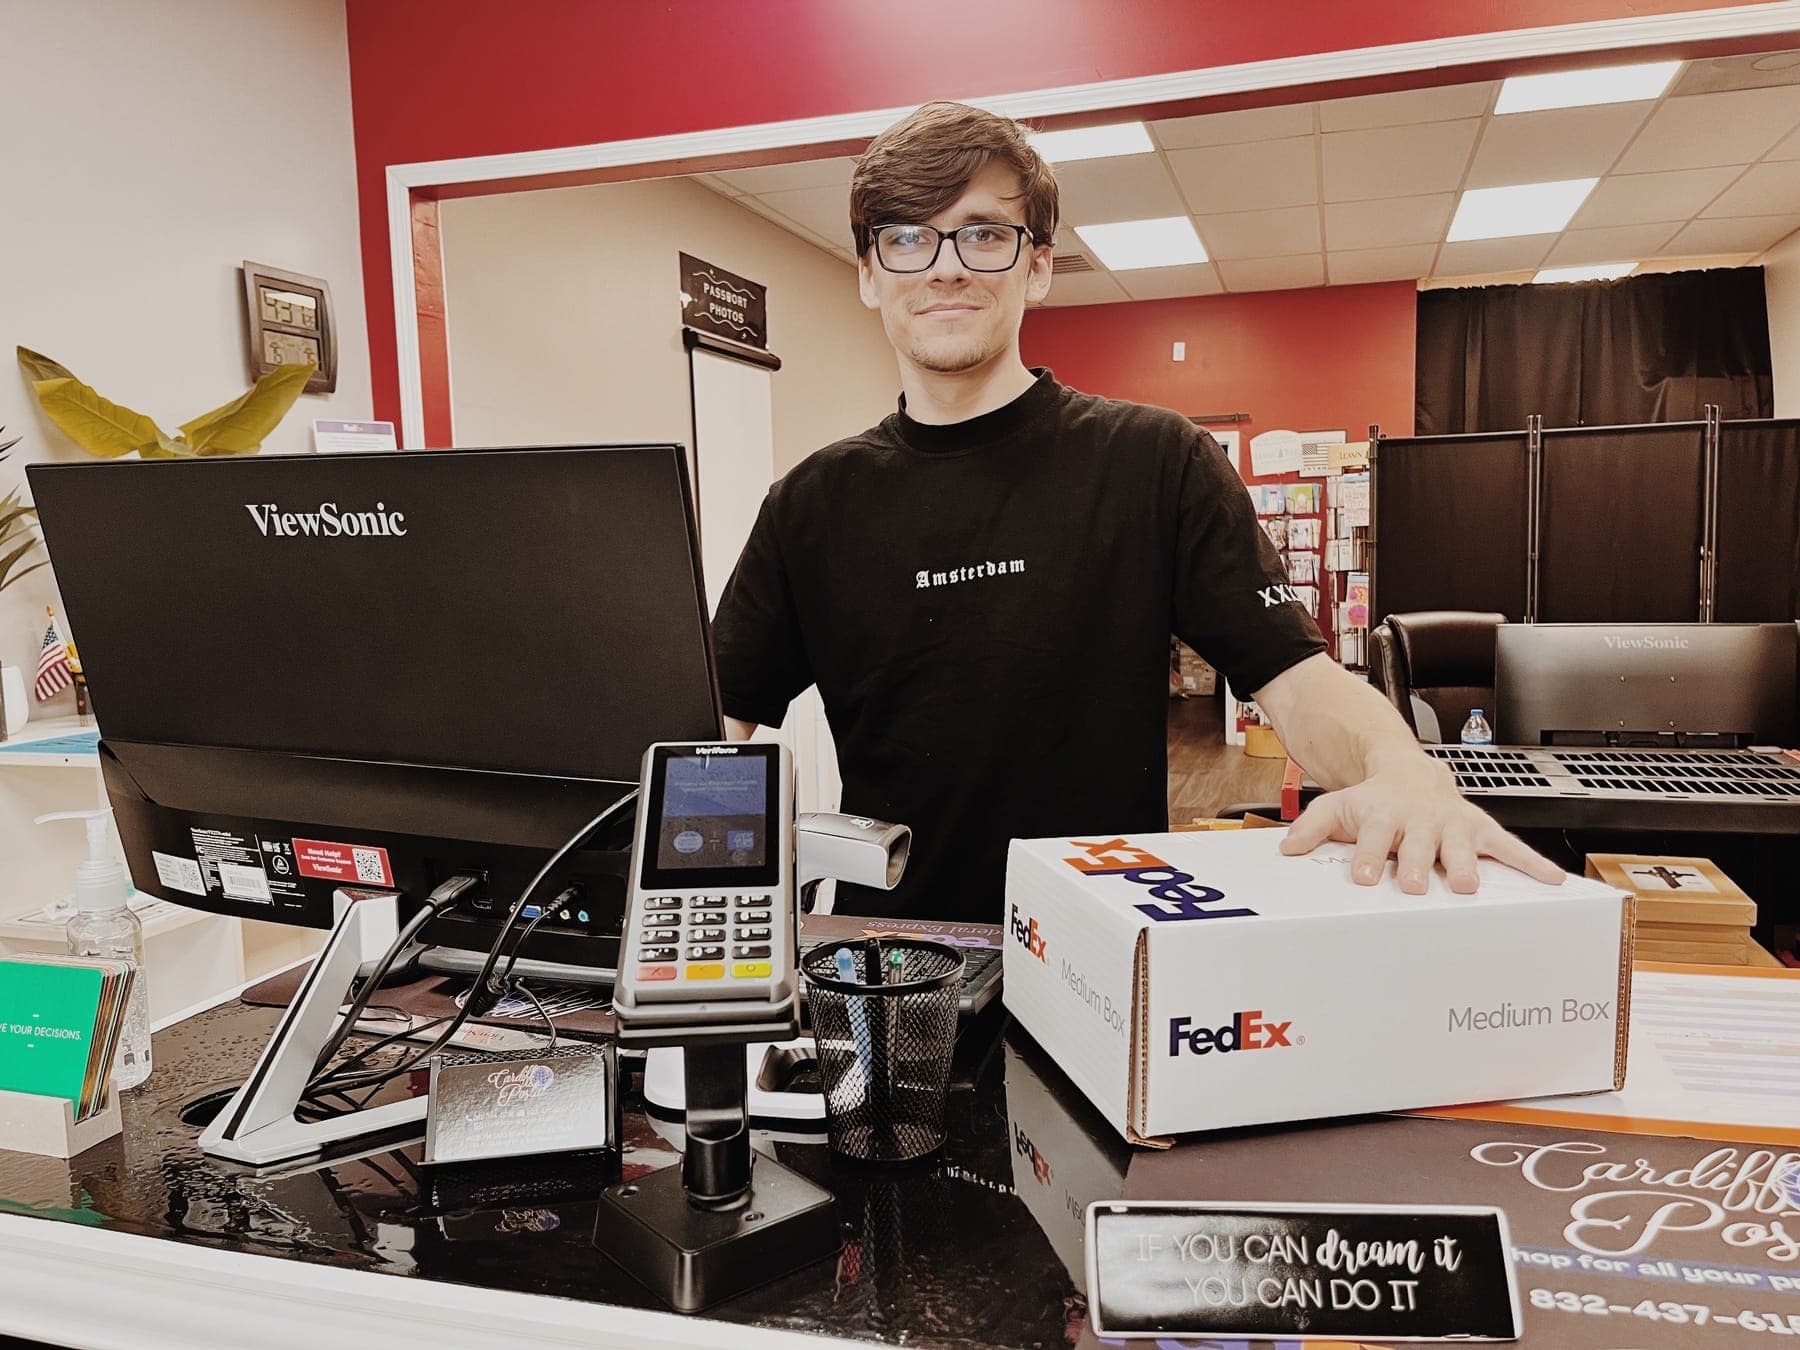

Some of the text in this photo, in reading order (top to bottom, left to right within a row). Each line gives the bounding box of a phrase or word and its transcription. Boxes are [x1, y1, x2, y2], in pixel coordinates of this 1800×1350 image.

[703, 282, 747, 308] PASSPORT
[709, 303, 745, 323] PHOTOS
[245, 502, 408, 537] ViewSonic
[916, 559, 1025, 589] Amsterdam
[1603, 635, 1689, 649] ViewSonic
[695, 746, 739, 755] Verifone
[1062, 837, 1260, 922] FedEx
[868, 921, 1003, 936] deral Express
[1011, 903, 1047, 965] FedEx
[1061, 957, 1126, 1038] Medium Box
[10, 1024, 33, 1035] YOUR
[34, 1026, 82, 1041] DECISIONS.
[1169, 1010, 1293, 1056] FedEx
[1448, 998, 1610, 1033] Medium Box
[1136, 1228, 1463, 1275] IF YOU CAN dream it
[1511, 1248, 1570, 1269] hop
[1577, 1254, 1630, 1273] for
[1638, 1261, 1678, 1278] all
[1682, 1266, 1763, 1284] your
[1184, 1276, 1419, 1311] YOU CAN DO IT
